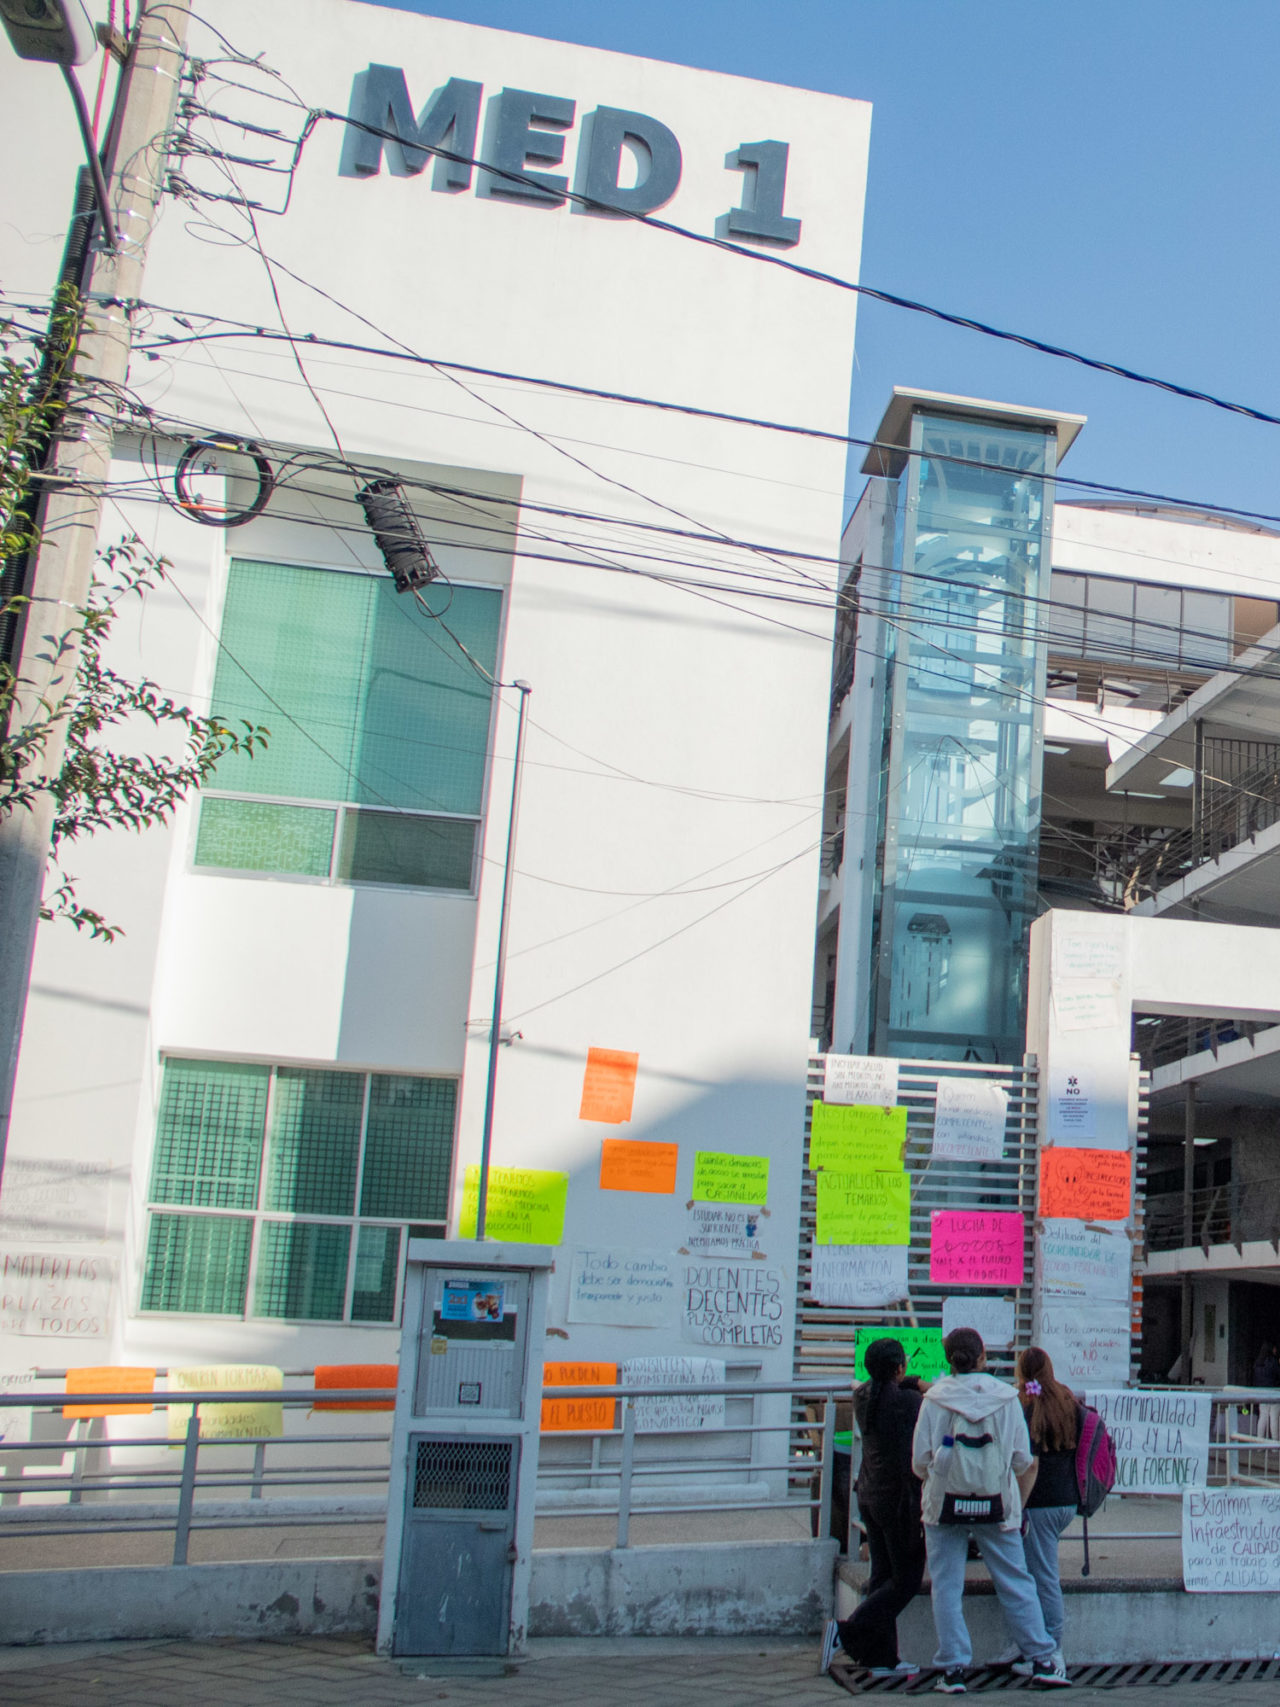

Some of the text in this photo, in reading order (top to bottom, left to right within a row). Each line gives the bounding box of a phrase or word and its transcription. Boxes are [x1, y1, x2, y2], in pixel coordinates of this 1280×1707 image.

[353, 62, 803, 247] MED 1
[951, 1217, 985, 1233] LUCHA
[576, 1250, 668, 1272] Todo cambio
[686, 1265, 781, 1294] DOCENTES
[687, 1288, 783, 1321] DECENTES
[40, 1316, 99, 1334] TODOS
[687, 1311, 734, 1327] PLAZAS
[702, 1324, 783, 1345] COMPLETAS
[1082, 1348, 1098, 1362] NO
[559, 1365, 601, 1383] PUEDEN
[566, 1402, 608, 1423] PUESTO
[1167, 1428, 1183, 1454] LA
[1143, 1456, 1200, 1487] FORENSE?
[1190, 1491, 1253, 1525] Exigimos
[1210, 1541, 1280, 1556] de CALIDAD
[1187, 1556, 1212, 1570] para
[1229, 1555, 1268, 1571] trabajo
[1213, 1570, 1270, 1588] CALIDAD
